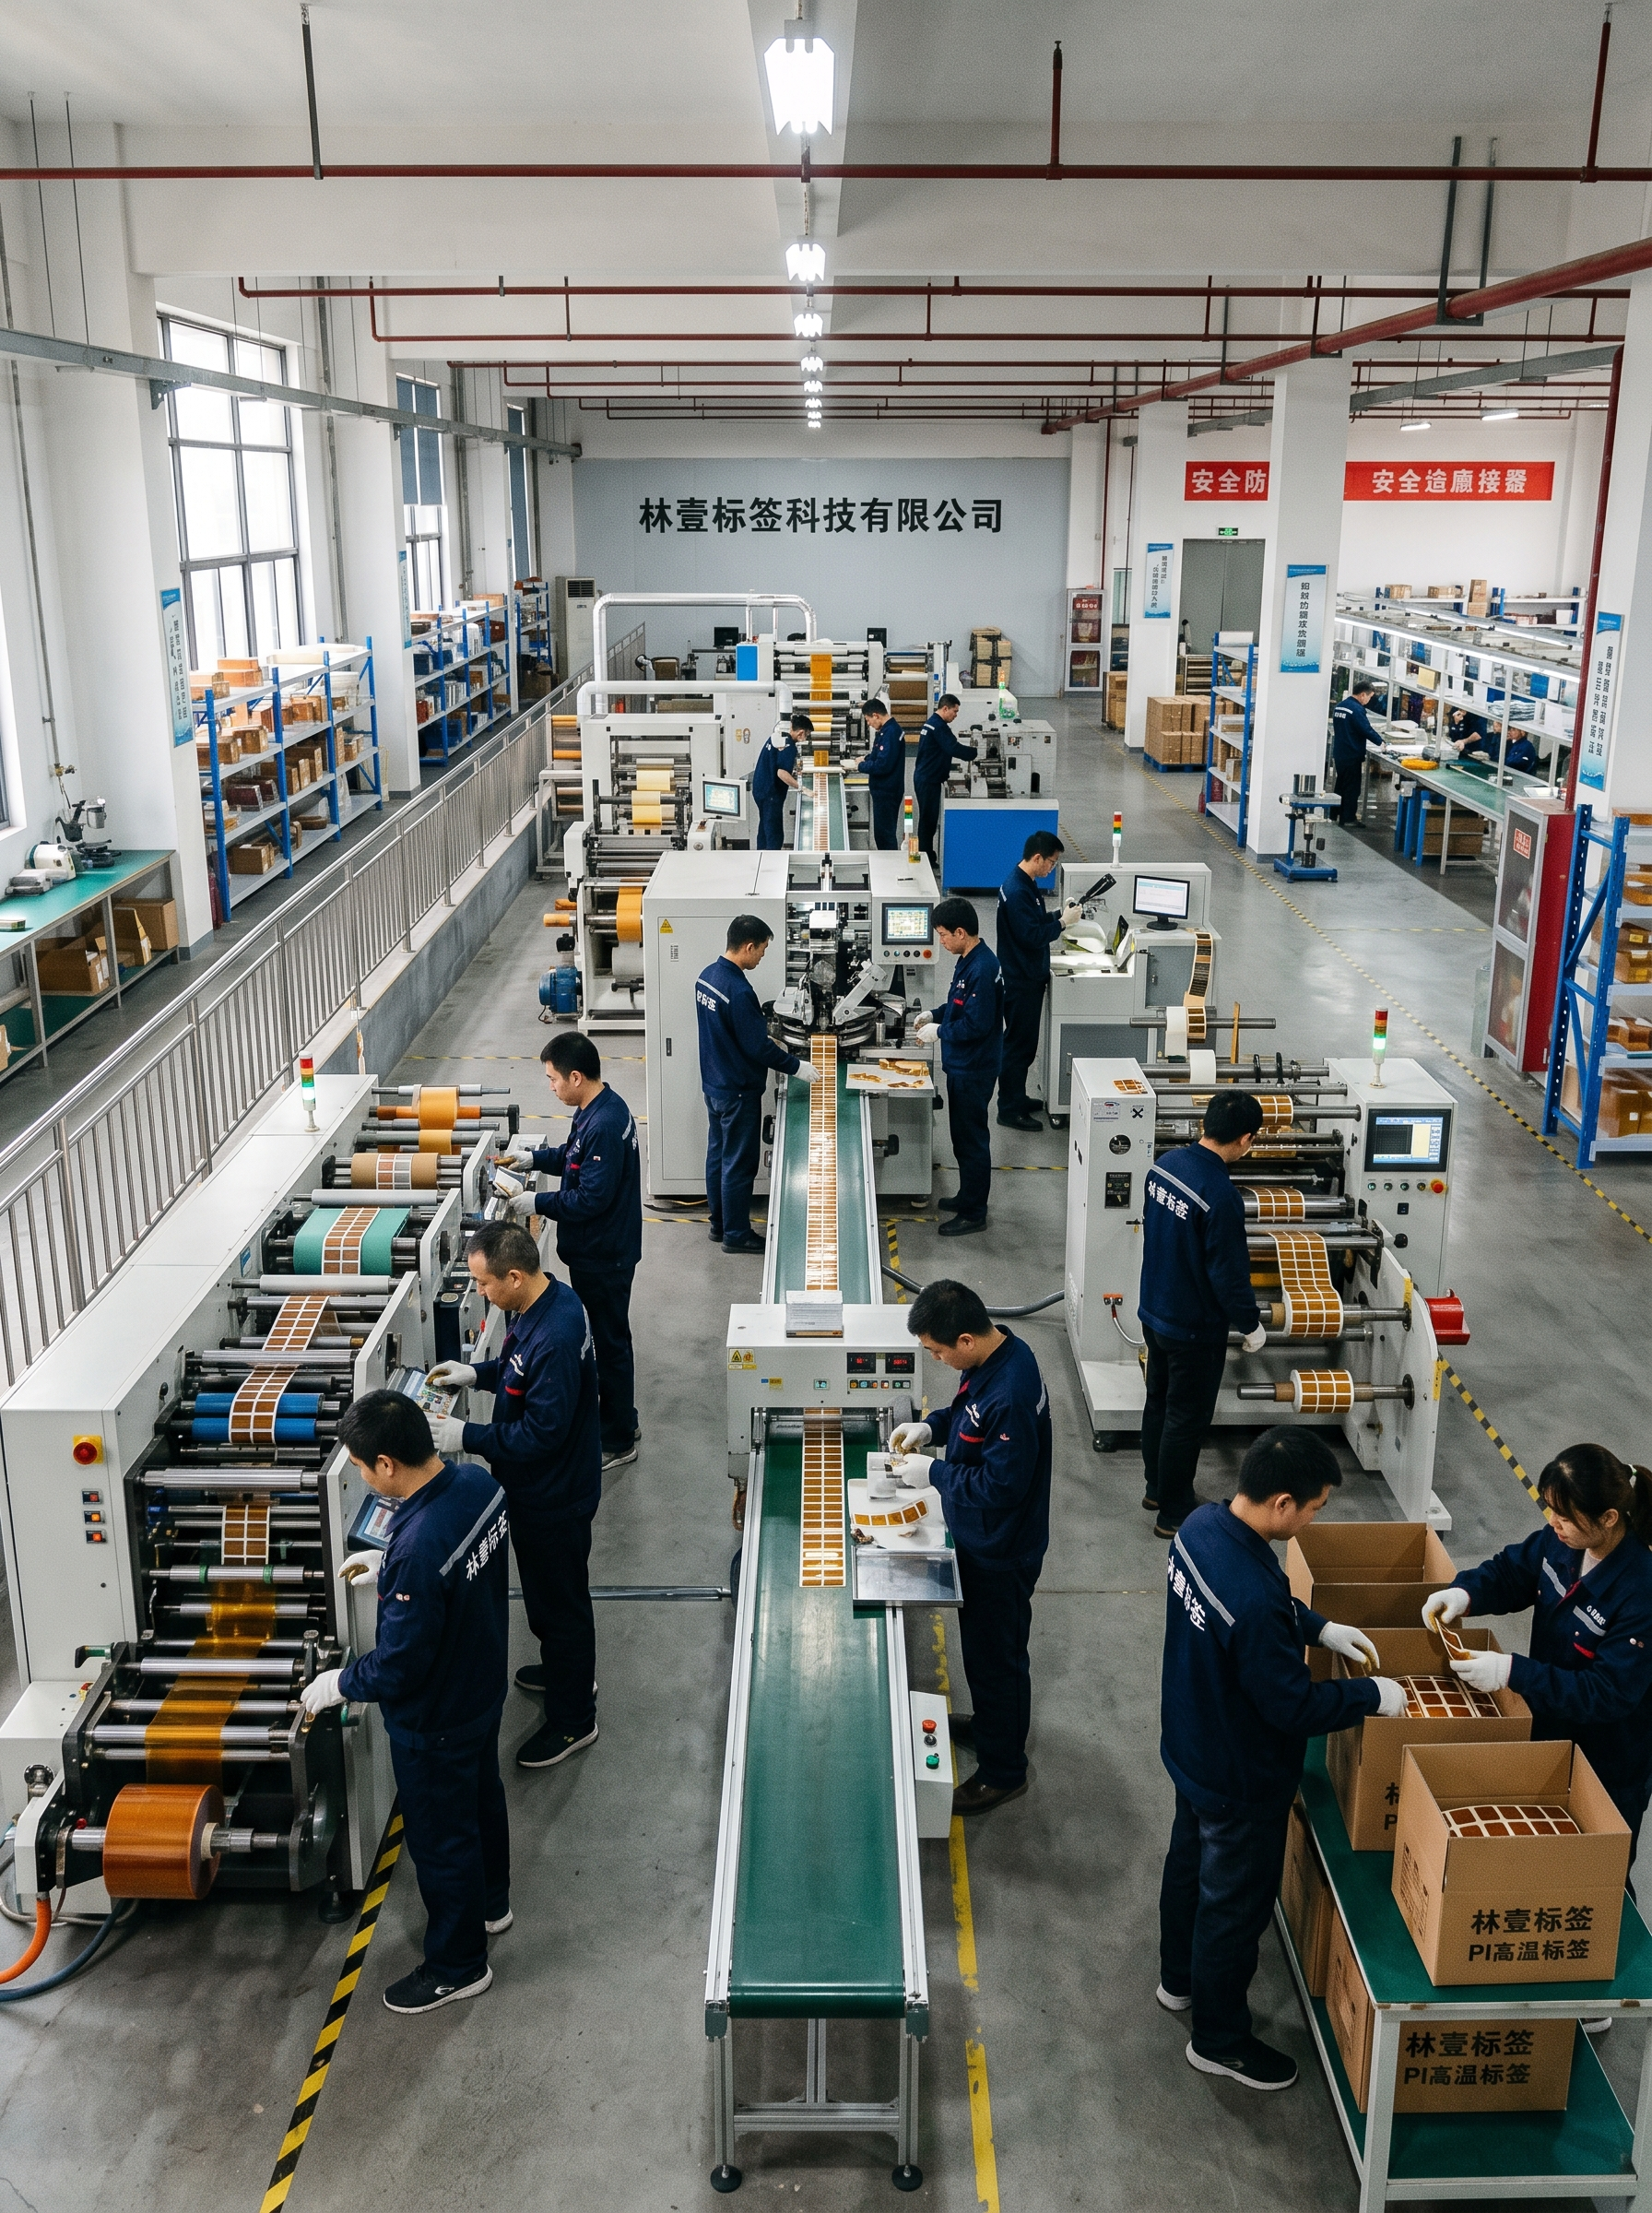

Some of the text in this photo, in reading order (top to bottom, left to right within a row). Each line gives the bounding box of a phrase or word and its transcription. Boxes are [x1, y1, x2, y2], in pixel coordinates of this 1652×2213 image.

[1192, 468, 1268, 493] 安全防
[639, 497, 1002, 533] 林壹标签科技有限公司
[1470, 1906, 1594, 1935] 林壹标签
[1469, 1938, 1590, 1962] PI高温标签
[1405, 2029, 1535, 2058] 林壹标签
[1403, 2063, 1531, 2086] PI高温标签
